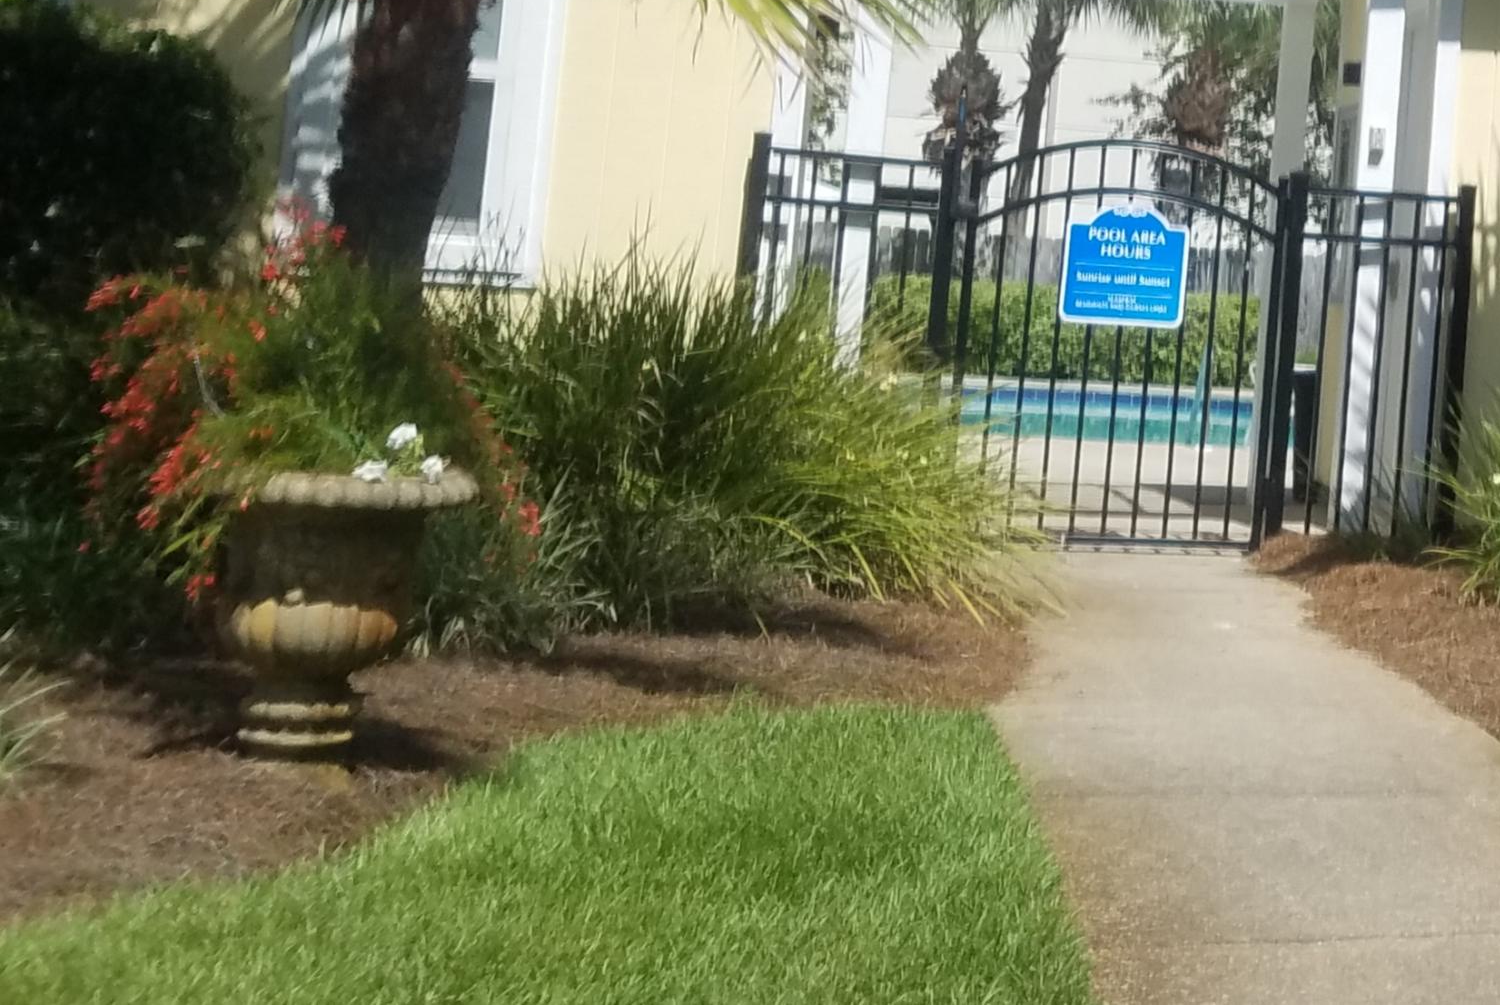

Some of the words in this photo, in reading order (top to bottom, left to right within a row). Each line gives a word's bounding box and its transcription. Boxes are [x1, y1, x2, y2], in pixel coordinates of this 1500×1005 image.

[1088, 226, 1127, 243] POOL
[1131, 229, 1166, 246] AREA
[1100, 243, 1151, 260] HOURS
